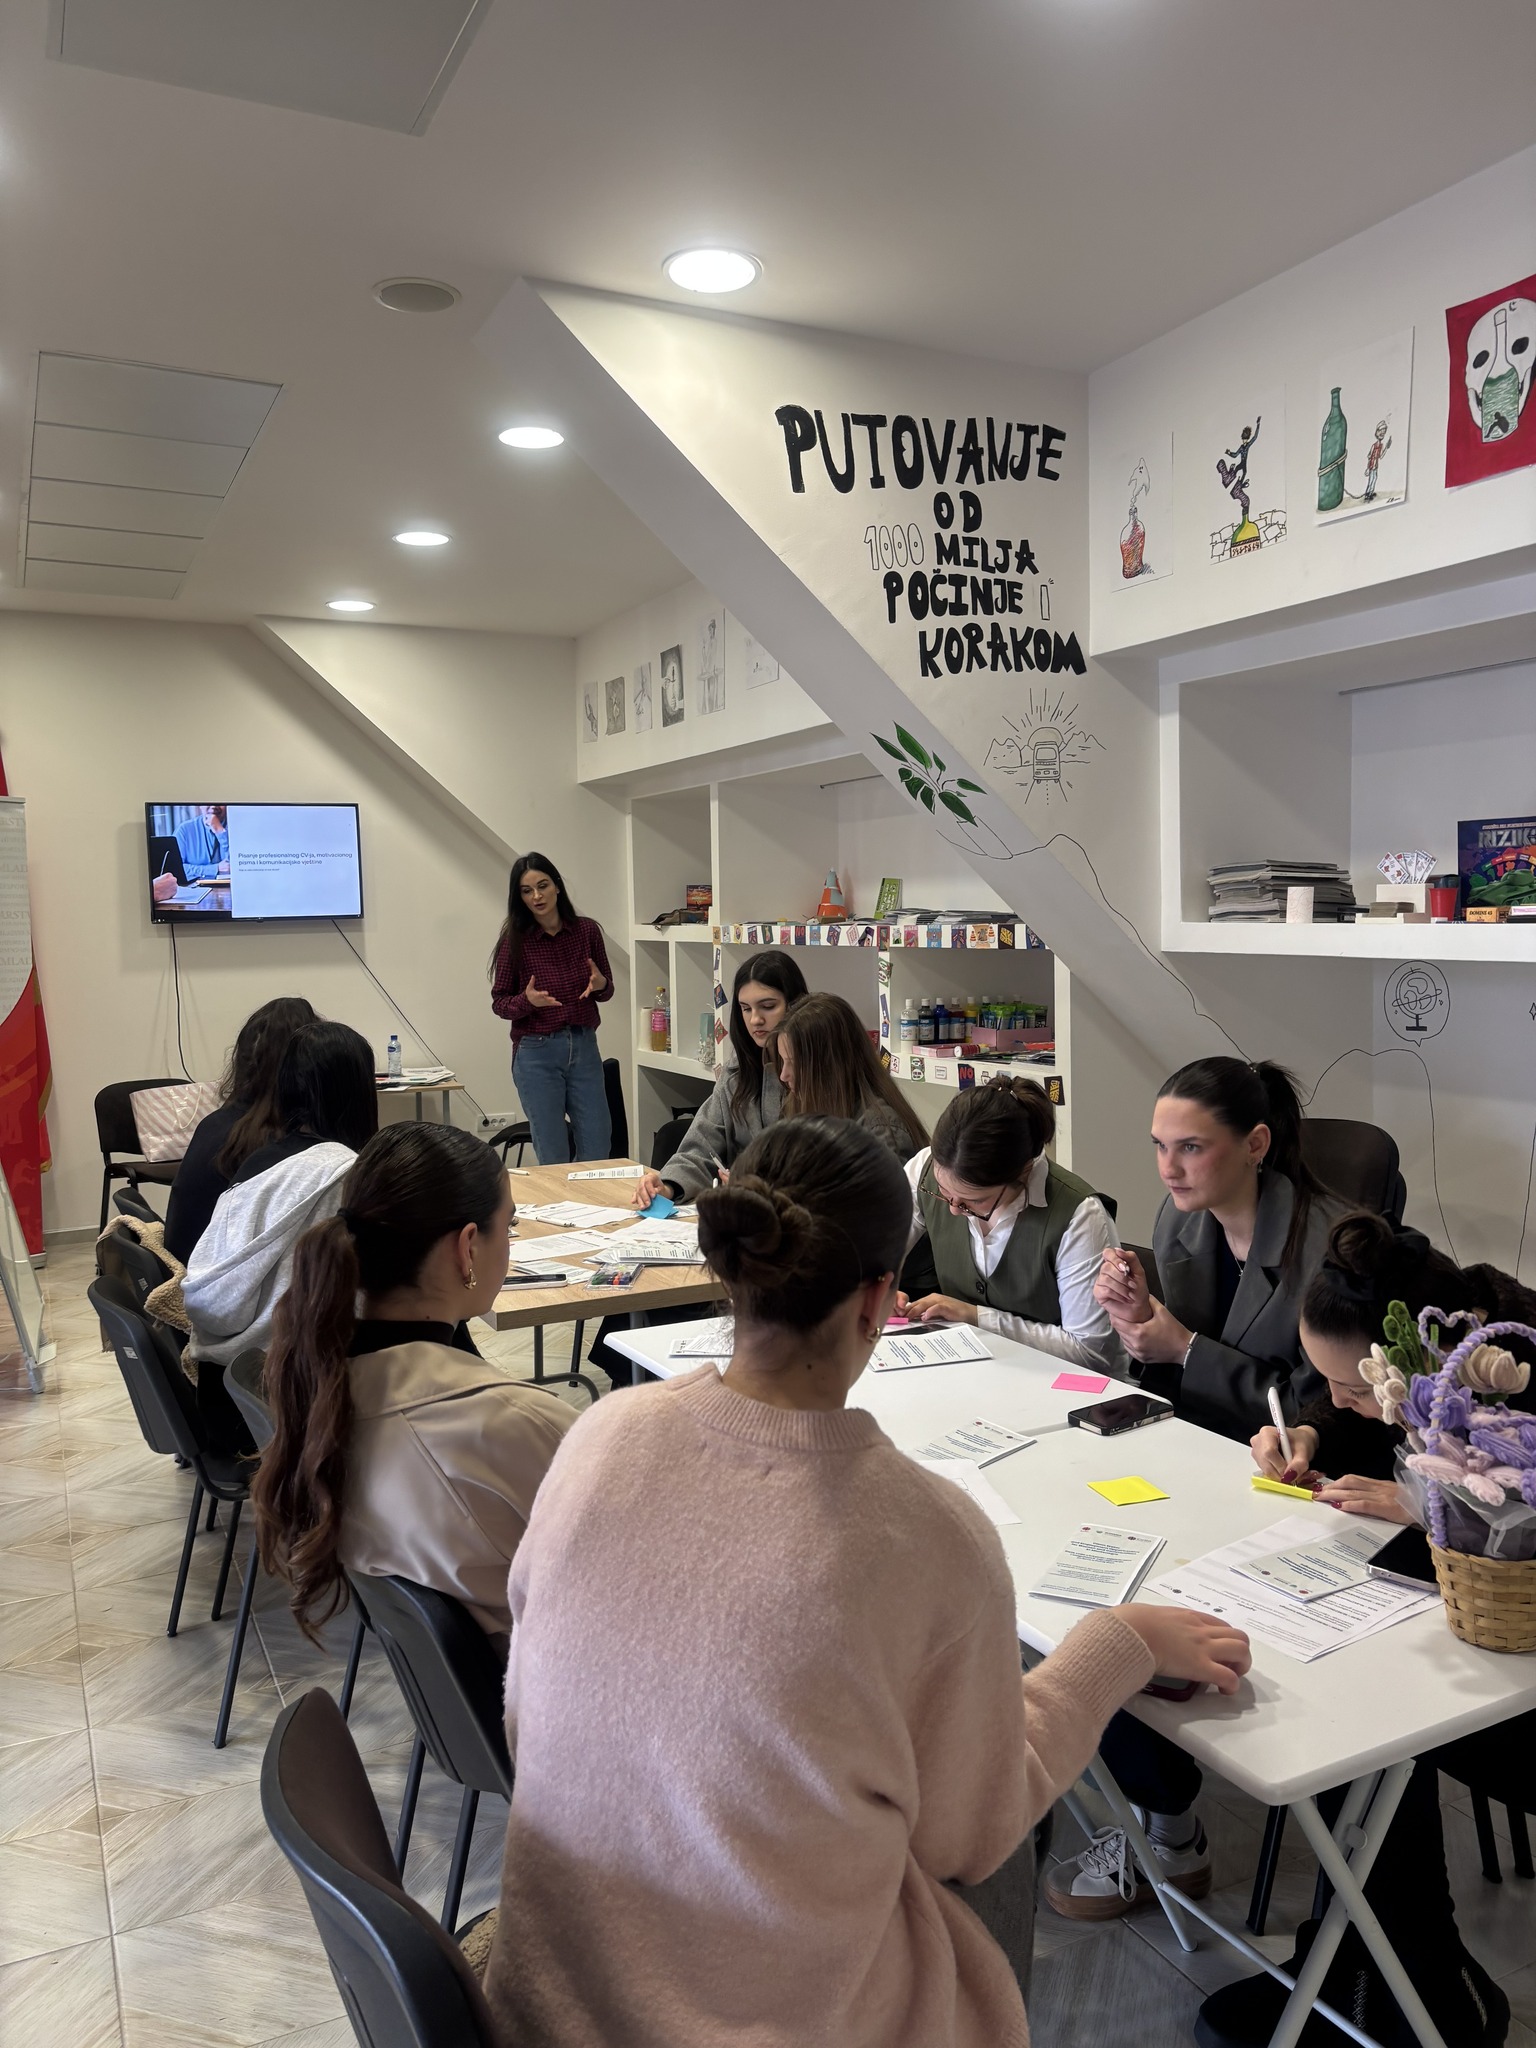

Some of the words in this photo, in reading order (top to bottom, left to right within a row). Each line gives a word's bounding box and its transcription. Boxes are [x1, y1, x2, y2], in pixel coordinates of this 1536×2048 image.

[775, 404, 1066, 493] PUTOVANJE
[934, 491, 982, 533] OD
[864, 523, 925, 570] 1000
[934, 532, 1039, 575] MILJA
[883, 568, 1023, 623] POČINJE
[919, 622, 1087, 679] KORAKOM
[960, 1066, 974, 1080] NO
